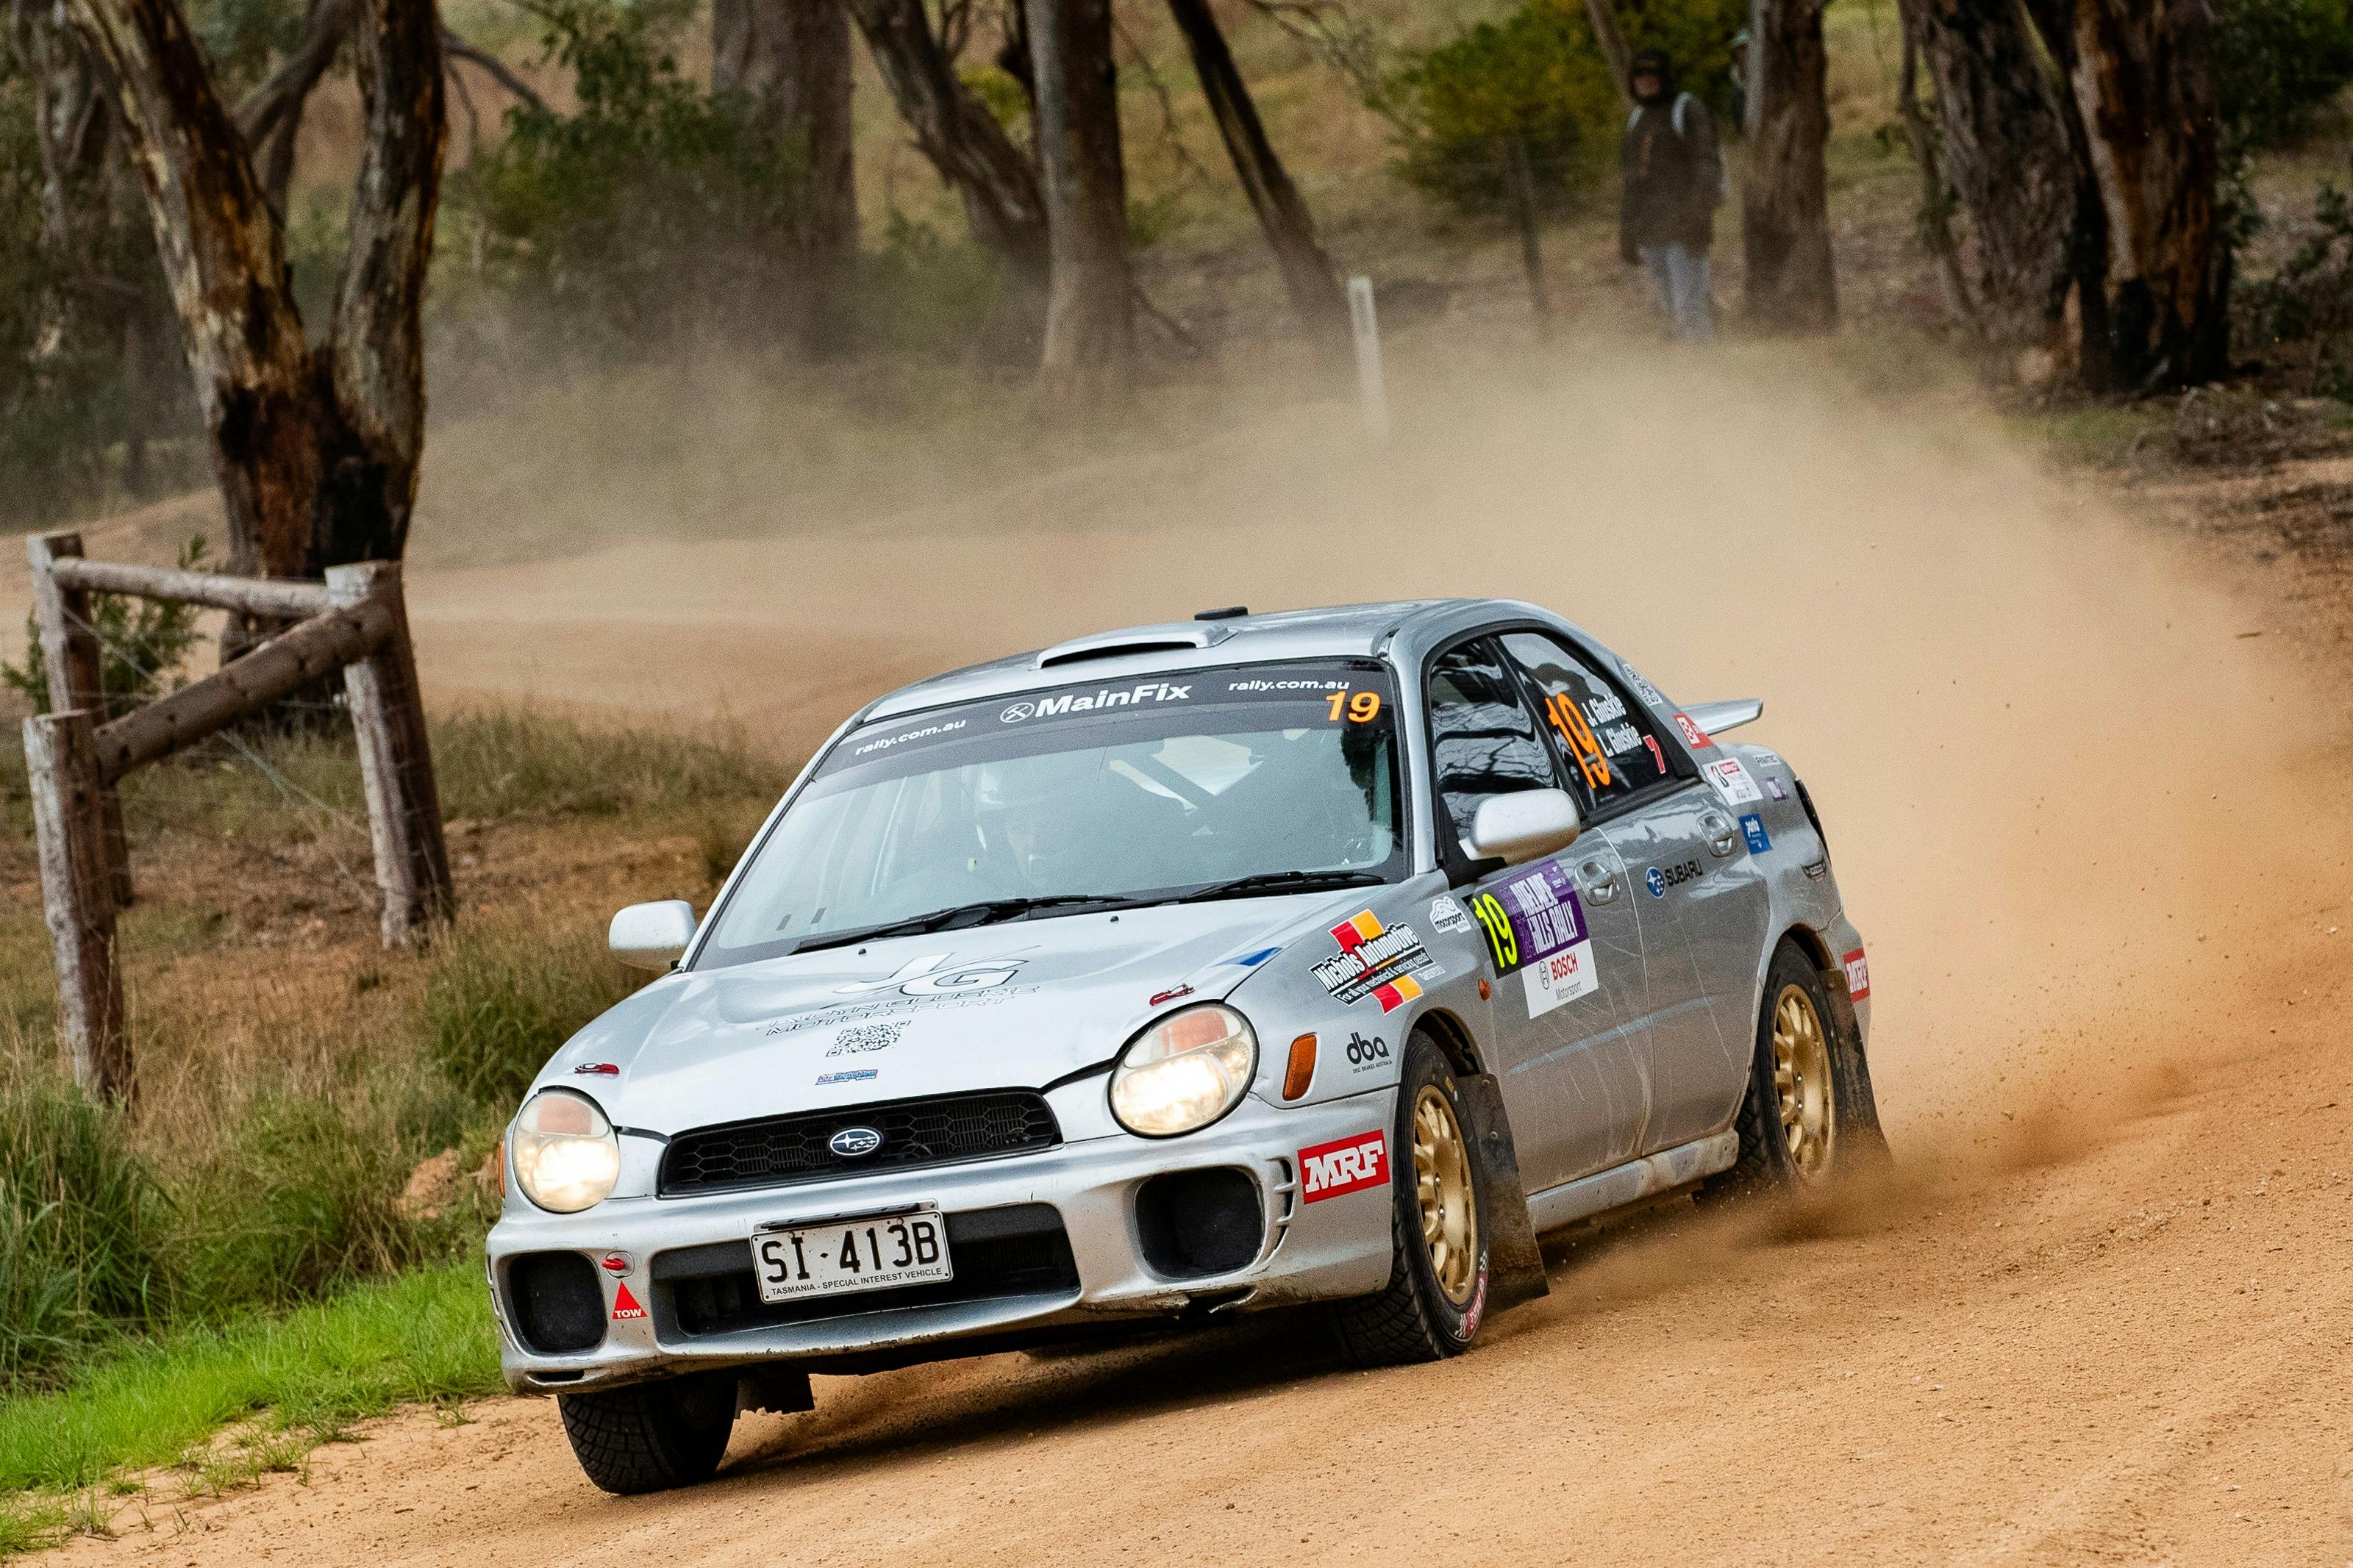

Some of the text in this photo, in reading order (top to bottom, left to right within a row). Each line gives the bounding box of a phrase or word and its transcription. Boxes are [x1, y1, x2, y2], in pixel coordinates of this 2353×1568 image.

[1035, 683, 1193, 717] MainFix
[1229, 680, 1350, 692] rally.com.au
[1326, 690, 1381, 723] 19
[1581, 693, 1627, 728] J. Gluskie
[855, 720, 966, 756] rally.com.au
[1545, 693, 1610, 789] 19
[1596, 733, 1615, 758] L.
[1606, 722, 1643, 754] Gluskie
[1665, 858, 1704, 887] SUBARU
[1435, 912, 1465, 930] motorsport
[1472, 893, 1518, 968] 19
[1527, 911, 1556, 954] HILLS
[1548, 901, 1579, 945] RALLY
[1313, 926, 1419, 991] Nichols Automotive
[1551, 951, 1579, 981] BOSCH
[1555, 981, 1583, 1001] Motorsport
[765, 996, 1015, 1036] MOTORSPORT
[1346, 1031, 1390, 1064] dba
[1304, 1140, 1384, 1193] MRF
[771, 1284, 815, 1295] TASMANIA
[822, 1278, 859, 1289] SPECIAL
[860, 1272, 902, 1284] INTEREST
[904, 1267, 943, 1279] VEHICLE
[615, 1309, 641, 1318] TOW
